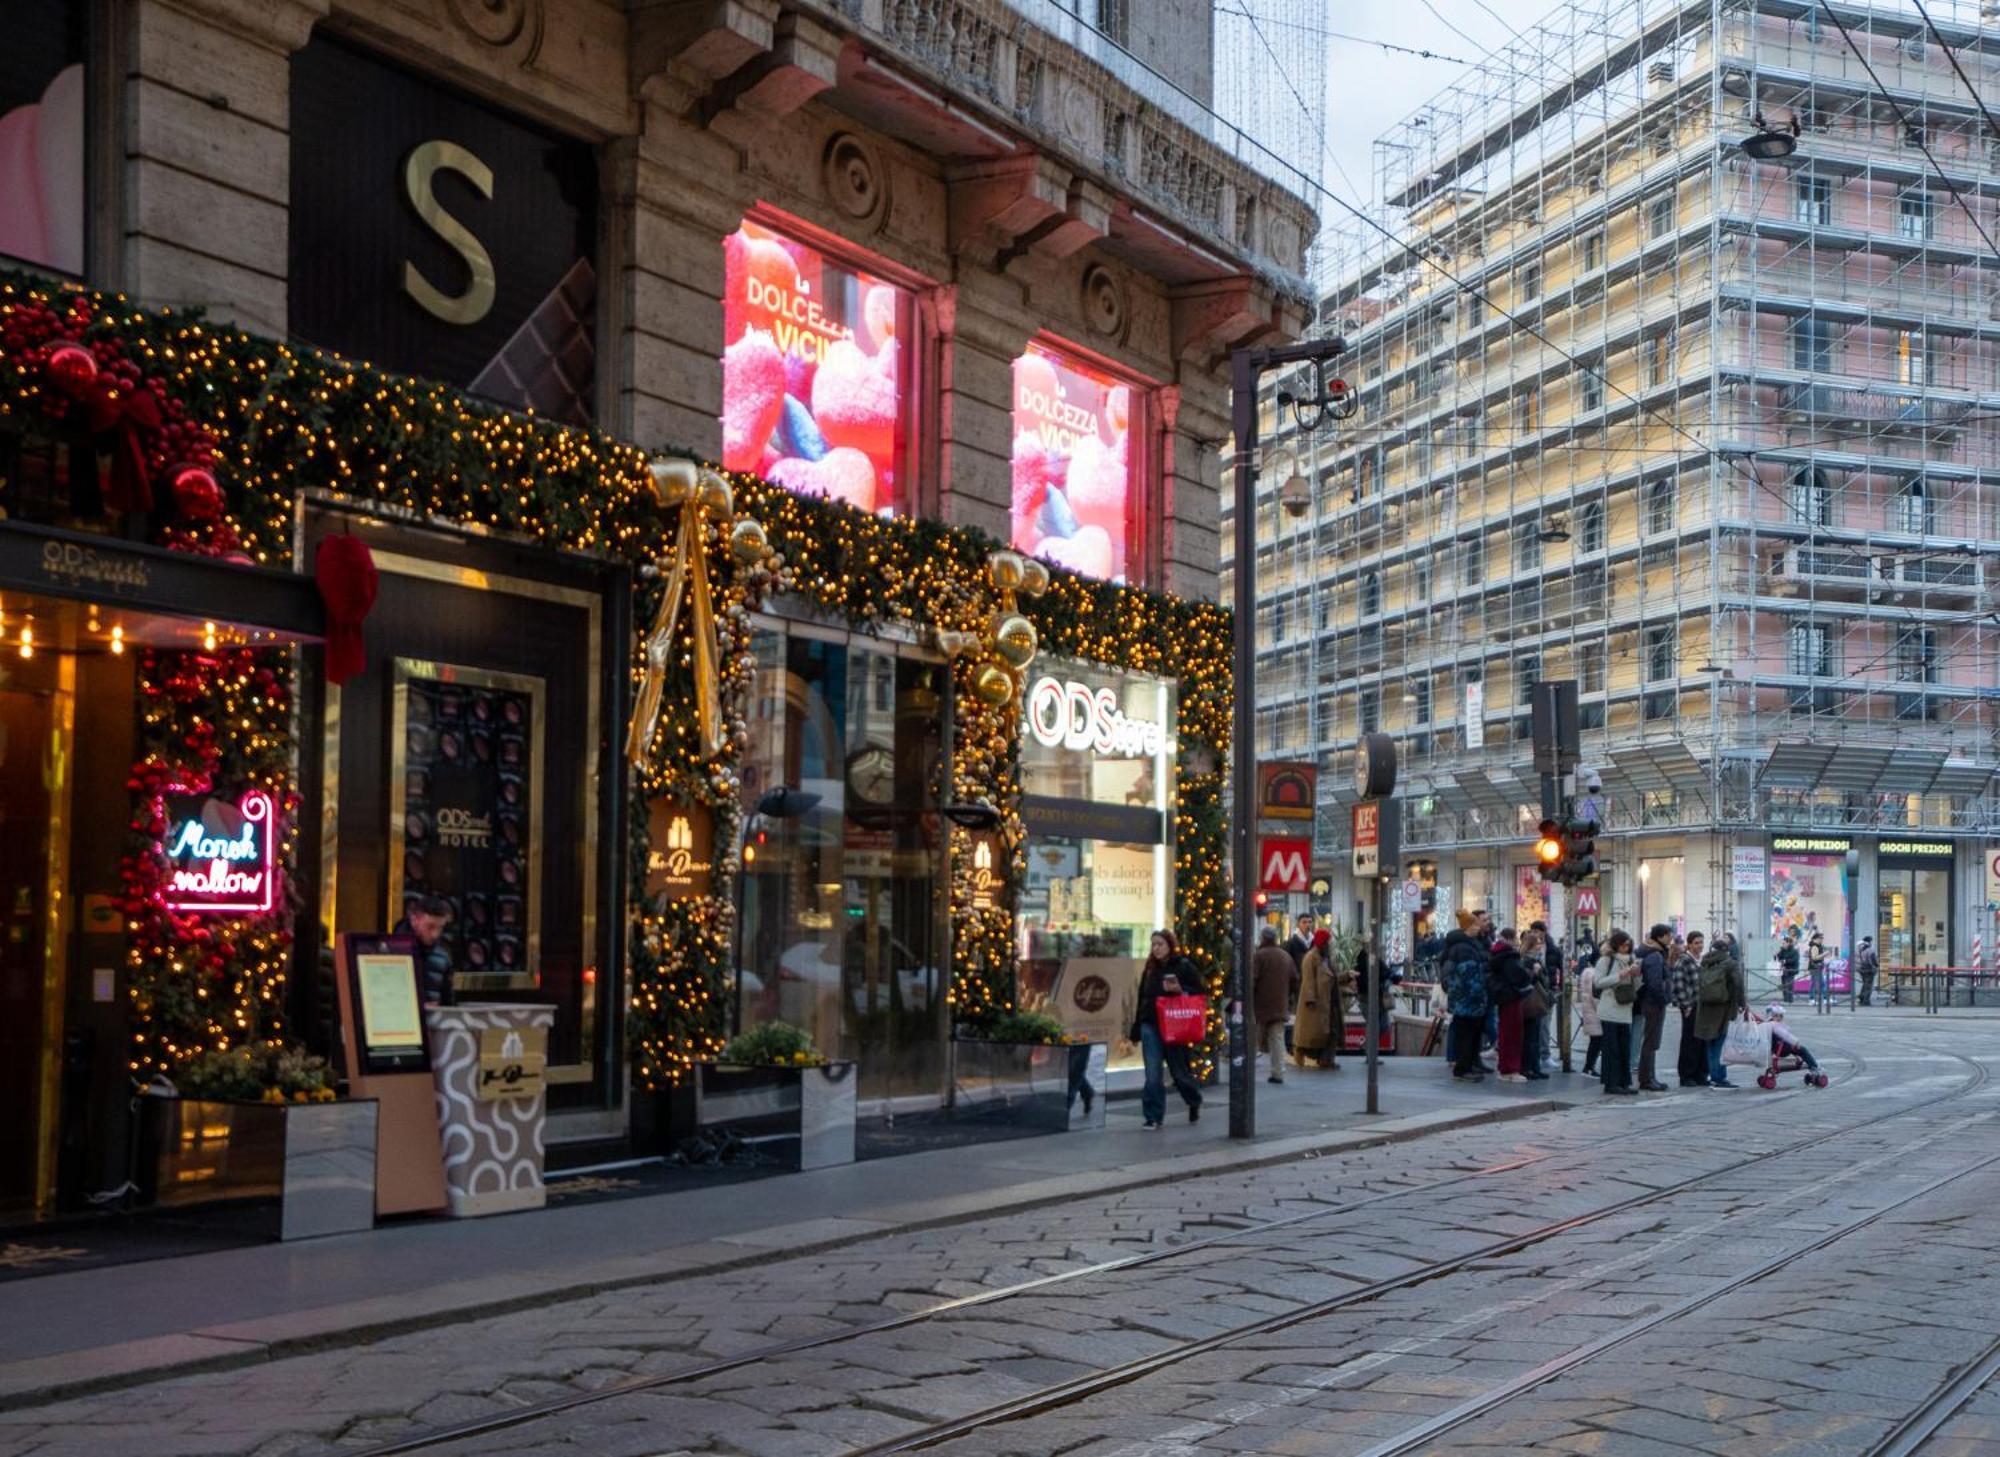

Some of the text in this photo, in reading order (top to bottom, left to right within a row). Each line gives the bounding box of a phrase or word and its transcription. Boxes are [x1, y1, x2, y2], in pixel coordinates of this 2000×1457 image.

[402, 139, 497, 326] S
[795, 273, 810, 295] La
[1020, 384, 1099, 436] DOLCEZZA
[1030, 676, 1158, 756] ODStore
[1357, 805, 1377, 831] KFC
[440, 834, 489, 848] HOTEL
[1773, 839, 1850, 850] GIOCHI PREZIOSI
[1879, 842, 1953, 854] GIOCHI PREZIOSI
[1263, 850, 1308, 883] M
[1578, 893, 1598, 911] M
